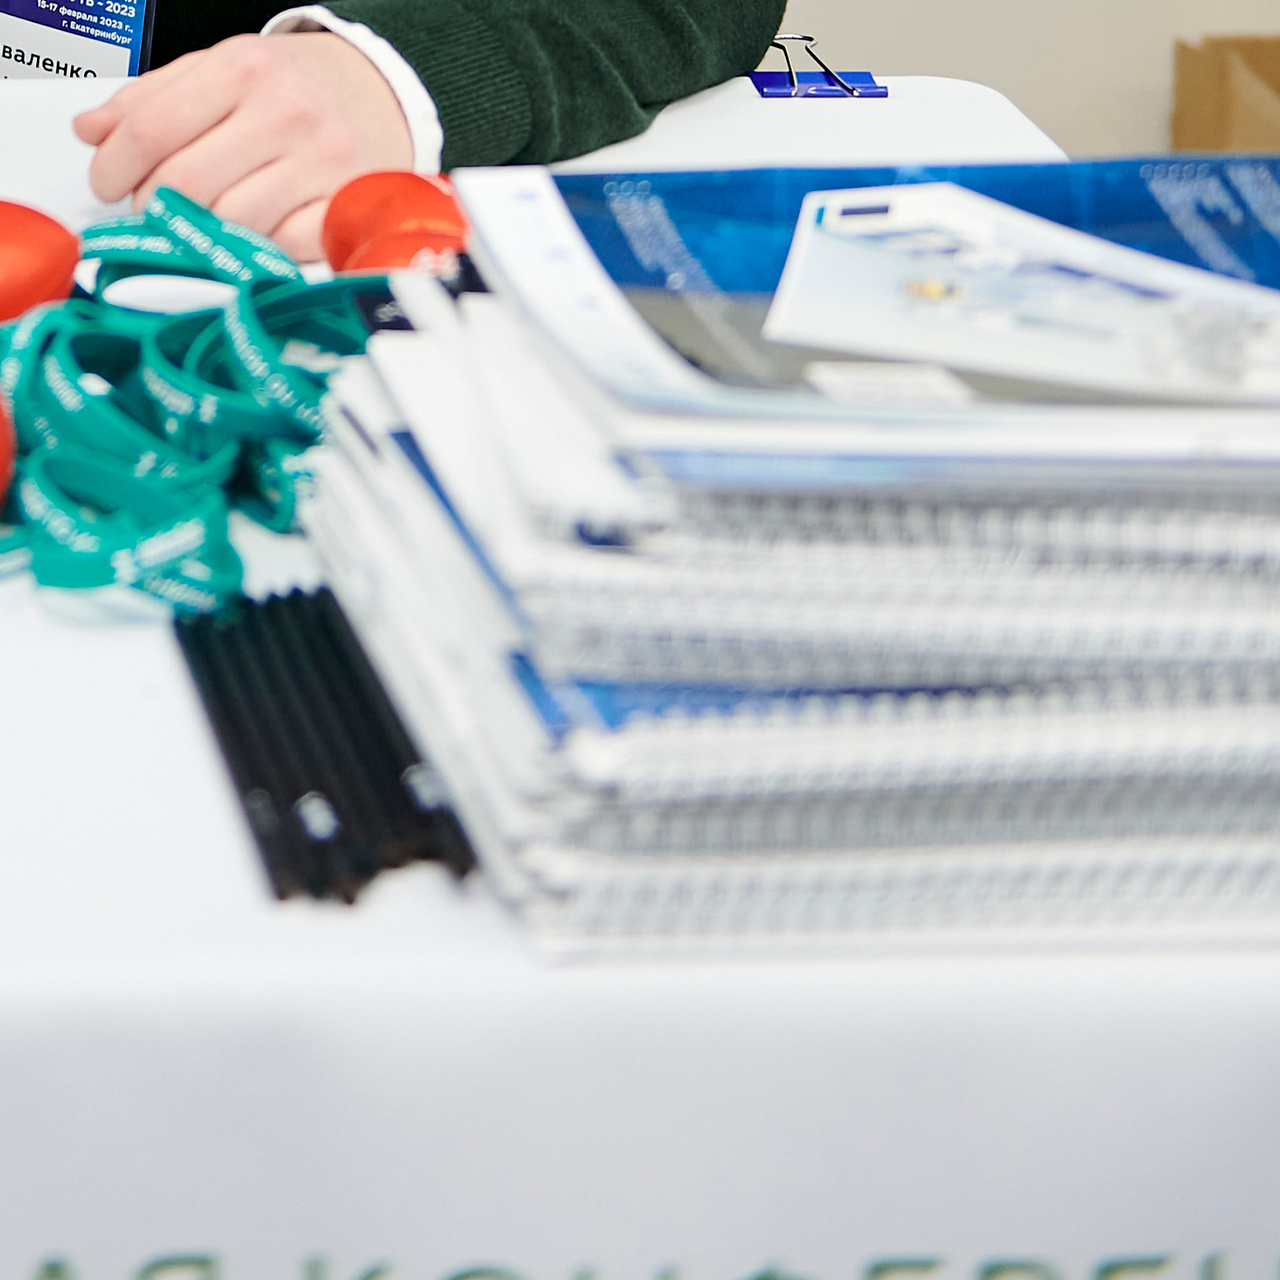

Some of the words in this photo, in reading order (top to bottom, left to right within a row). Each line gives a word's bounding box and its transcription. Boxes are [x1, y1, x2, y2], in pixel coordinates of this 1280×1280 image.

[58, 5, 98, 23] февраля
[99, 16, 123, 30] 2023
[105, 0, 136, 18] 2023
[69, 20, 133, 45] Екатеринбург
